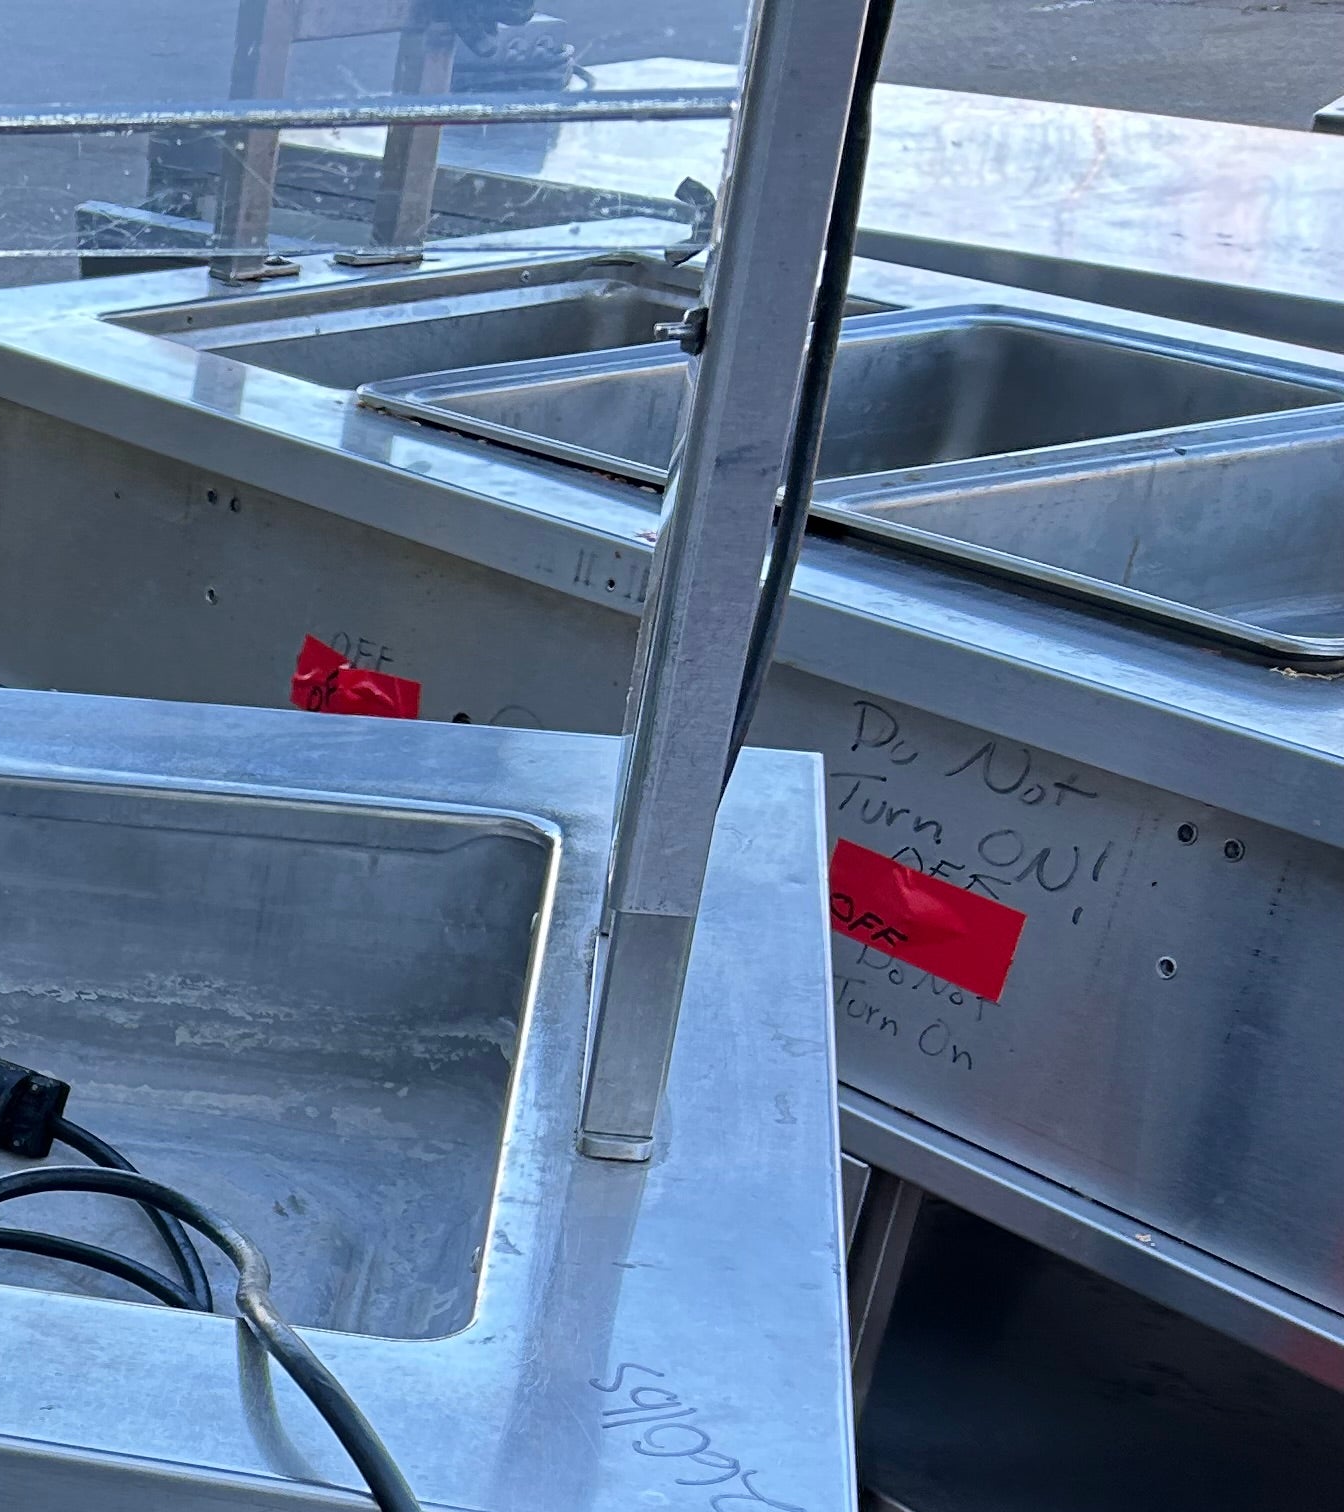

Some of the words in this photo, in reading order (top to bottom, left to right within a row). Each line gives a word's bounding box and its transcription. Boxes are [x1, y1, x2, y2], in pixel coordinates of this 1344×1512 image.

[852, 700, 918, 765] Do
[944, 740, 1099, 806] Not
[829, 772, 943, 845] Turn
[830, 892, 909, 948] OFF
[833, 974, 898, 1037] Turn
[918, 1018, 973, 1071] On
